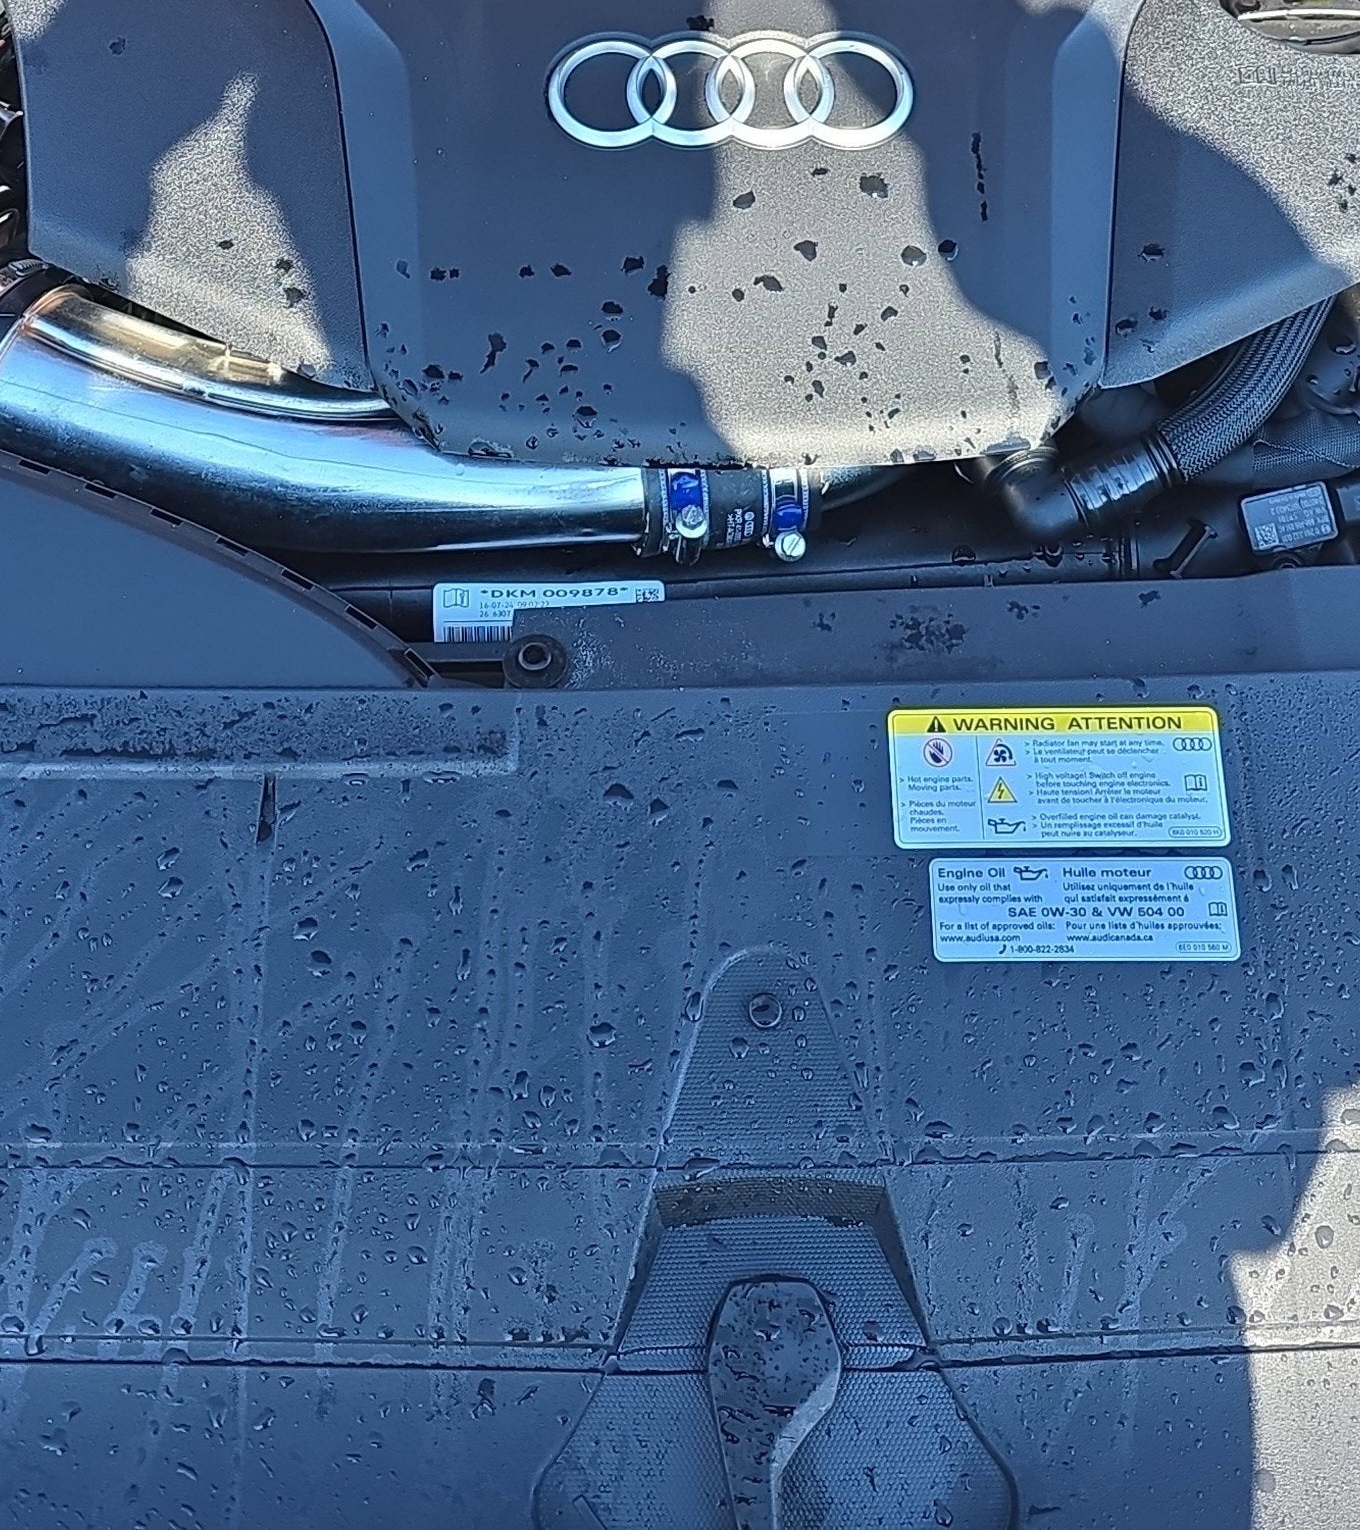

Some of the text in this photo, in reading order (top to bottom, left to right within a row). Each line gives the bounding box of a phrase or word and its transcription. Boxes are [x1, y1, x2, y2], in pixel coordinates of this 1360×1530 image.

[953, 715, 1183, 732] WARNING ATTENTION
[923, 776, 950, 784] engine
[1035, 772, 1054, 781] High
[1130, 772, 1156, 780] engine
[1063, 780, 1097, 788] touching
[1072, 796, 1102, 804] toucher
[1080, 813, 1107, 821] engine
[1136, 813, 1167, 821] damage
[1055, 821, 1102, 830] remplissage
[1094, 830, 1137, 838] catalyseur.
[938, 867, 1005, 880] Engine Oil
[1063, 868, 1152, 878] Huile moteur
[957, 883, 977, 893] only
[980, 883, 991, 891] oil
[1063, 883, 1095, 891] Utilisez
[1098, 884, 1152, 892] uniquement
[1153, 883, 1164, 891] de
[939, 895, 980, 904] expressly
[982, 895, 1021, 904] complies
[1065, 895, 1079, 904] qui
[1081, 894, 1116, 902] satisfait
[1118, 894, 1178, 903] expressément
[1008, 907, 1185, 917] SAE 0W-30 & VW 504 00
[940, 922, 955, 930] For
[965, 922, 978, 930] list
[981, 922, 989, 930] of
[992, 922, 1034, 931] approved
[1037, 922, 1055, 930] oils:
[1066, 922, 1086, 930] Pour
[1109, 922, 1127, 930] liste
[1011, 944, 1075, 954] 1-800-822-2834
